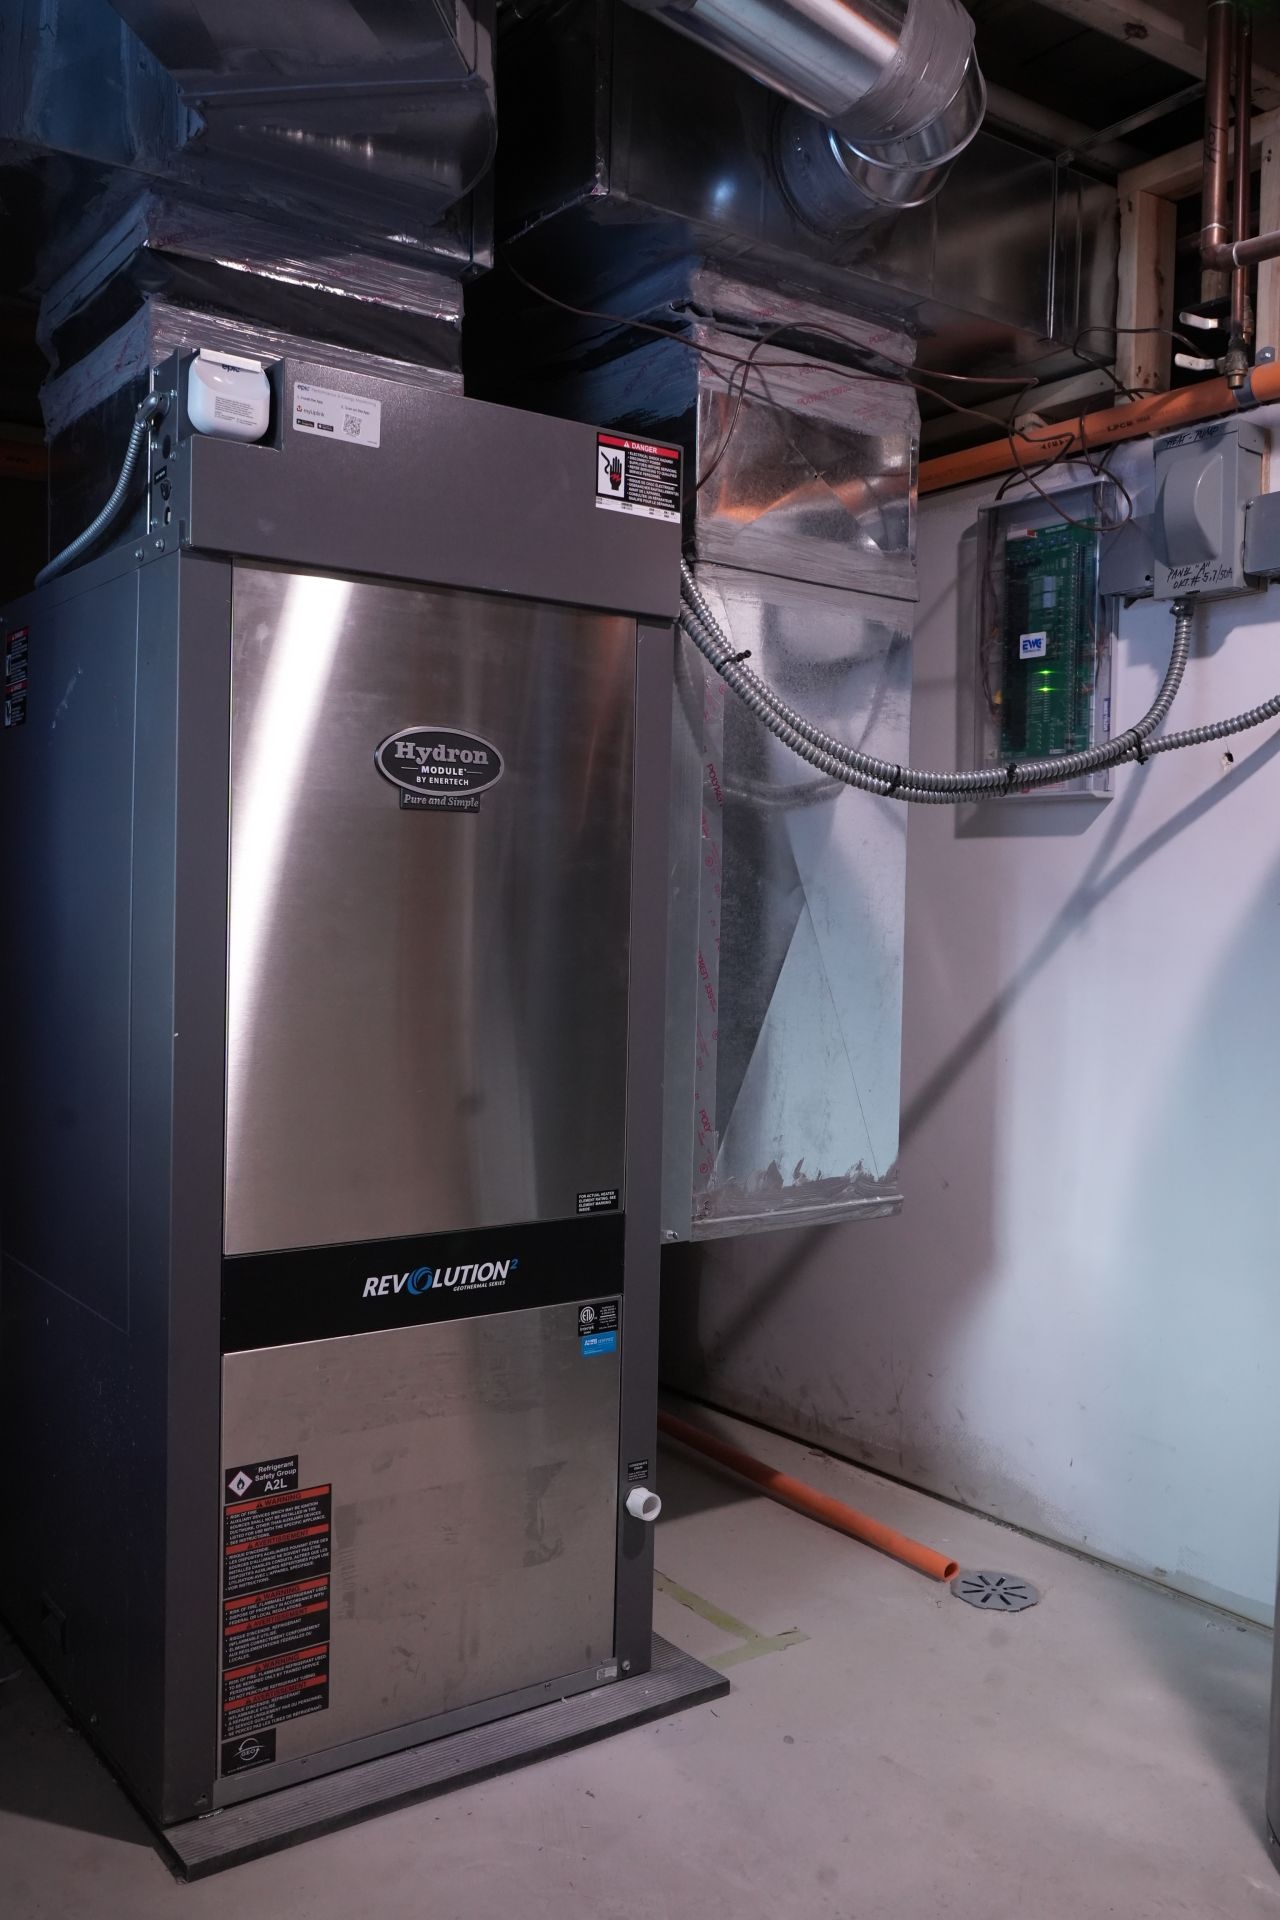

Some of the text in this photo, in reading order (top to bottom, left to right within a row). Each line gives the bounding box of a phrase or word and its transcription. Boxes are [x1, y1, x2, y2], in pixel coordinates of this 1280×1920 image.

[631, 443, 657, 454] DANGER
[394, 741, 489, 765] Hydron
[429, 777, 469, 786] ENERTECH
[403, 794, 479, 809] Pure and Simple
[453, 1279, 506, 1292] GEOTHERMAL SERIES
[258, 1461, 294, 1473] Refrigerant
[255, 1469, 297, 1482] Safety Group
[264, 1479, 288, 1492] A2L
[264, 1492, 302, 1506] WARNING
[263, 1585, 300, 1601] WARNING
[263, 1653, 299, 1669] WARNING
